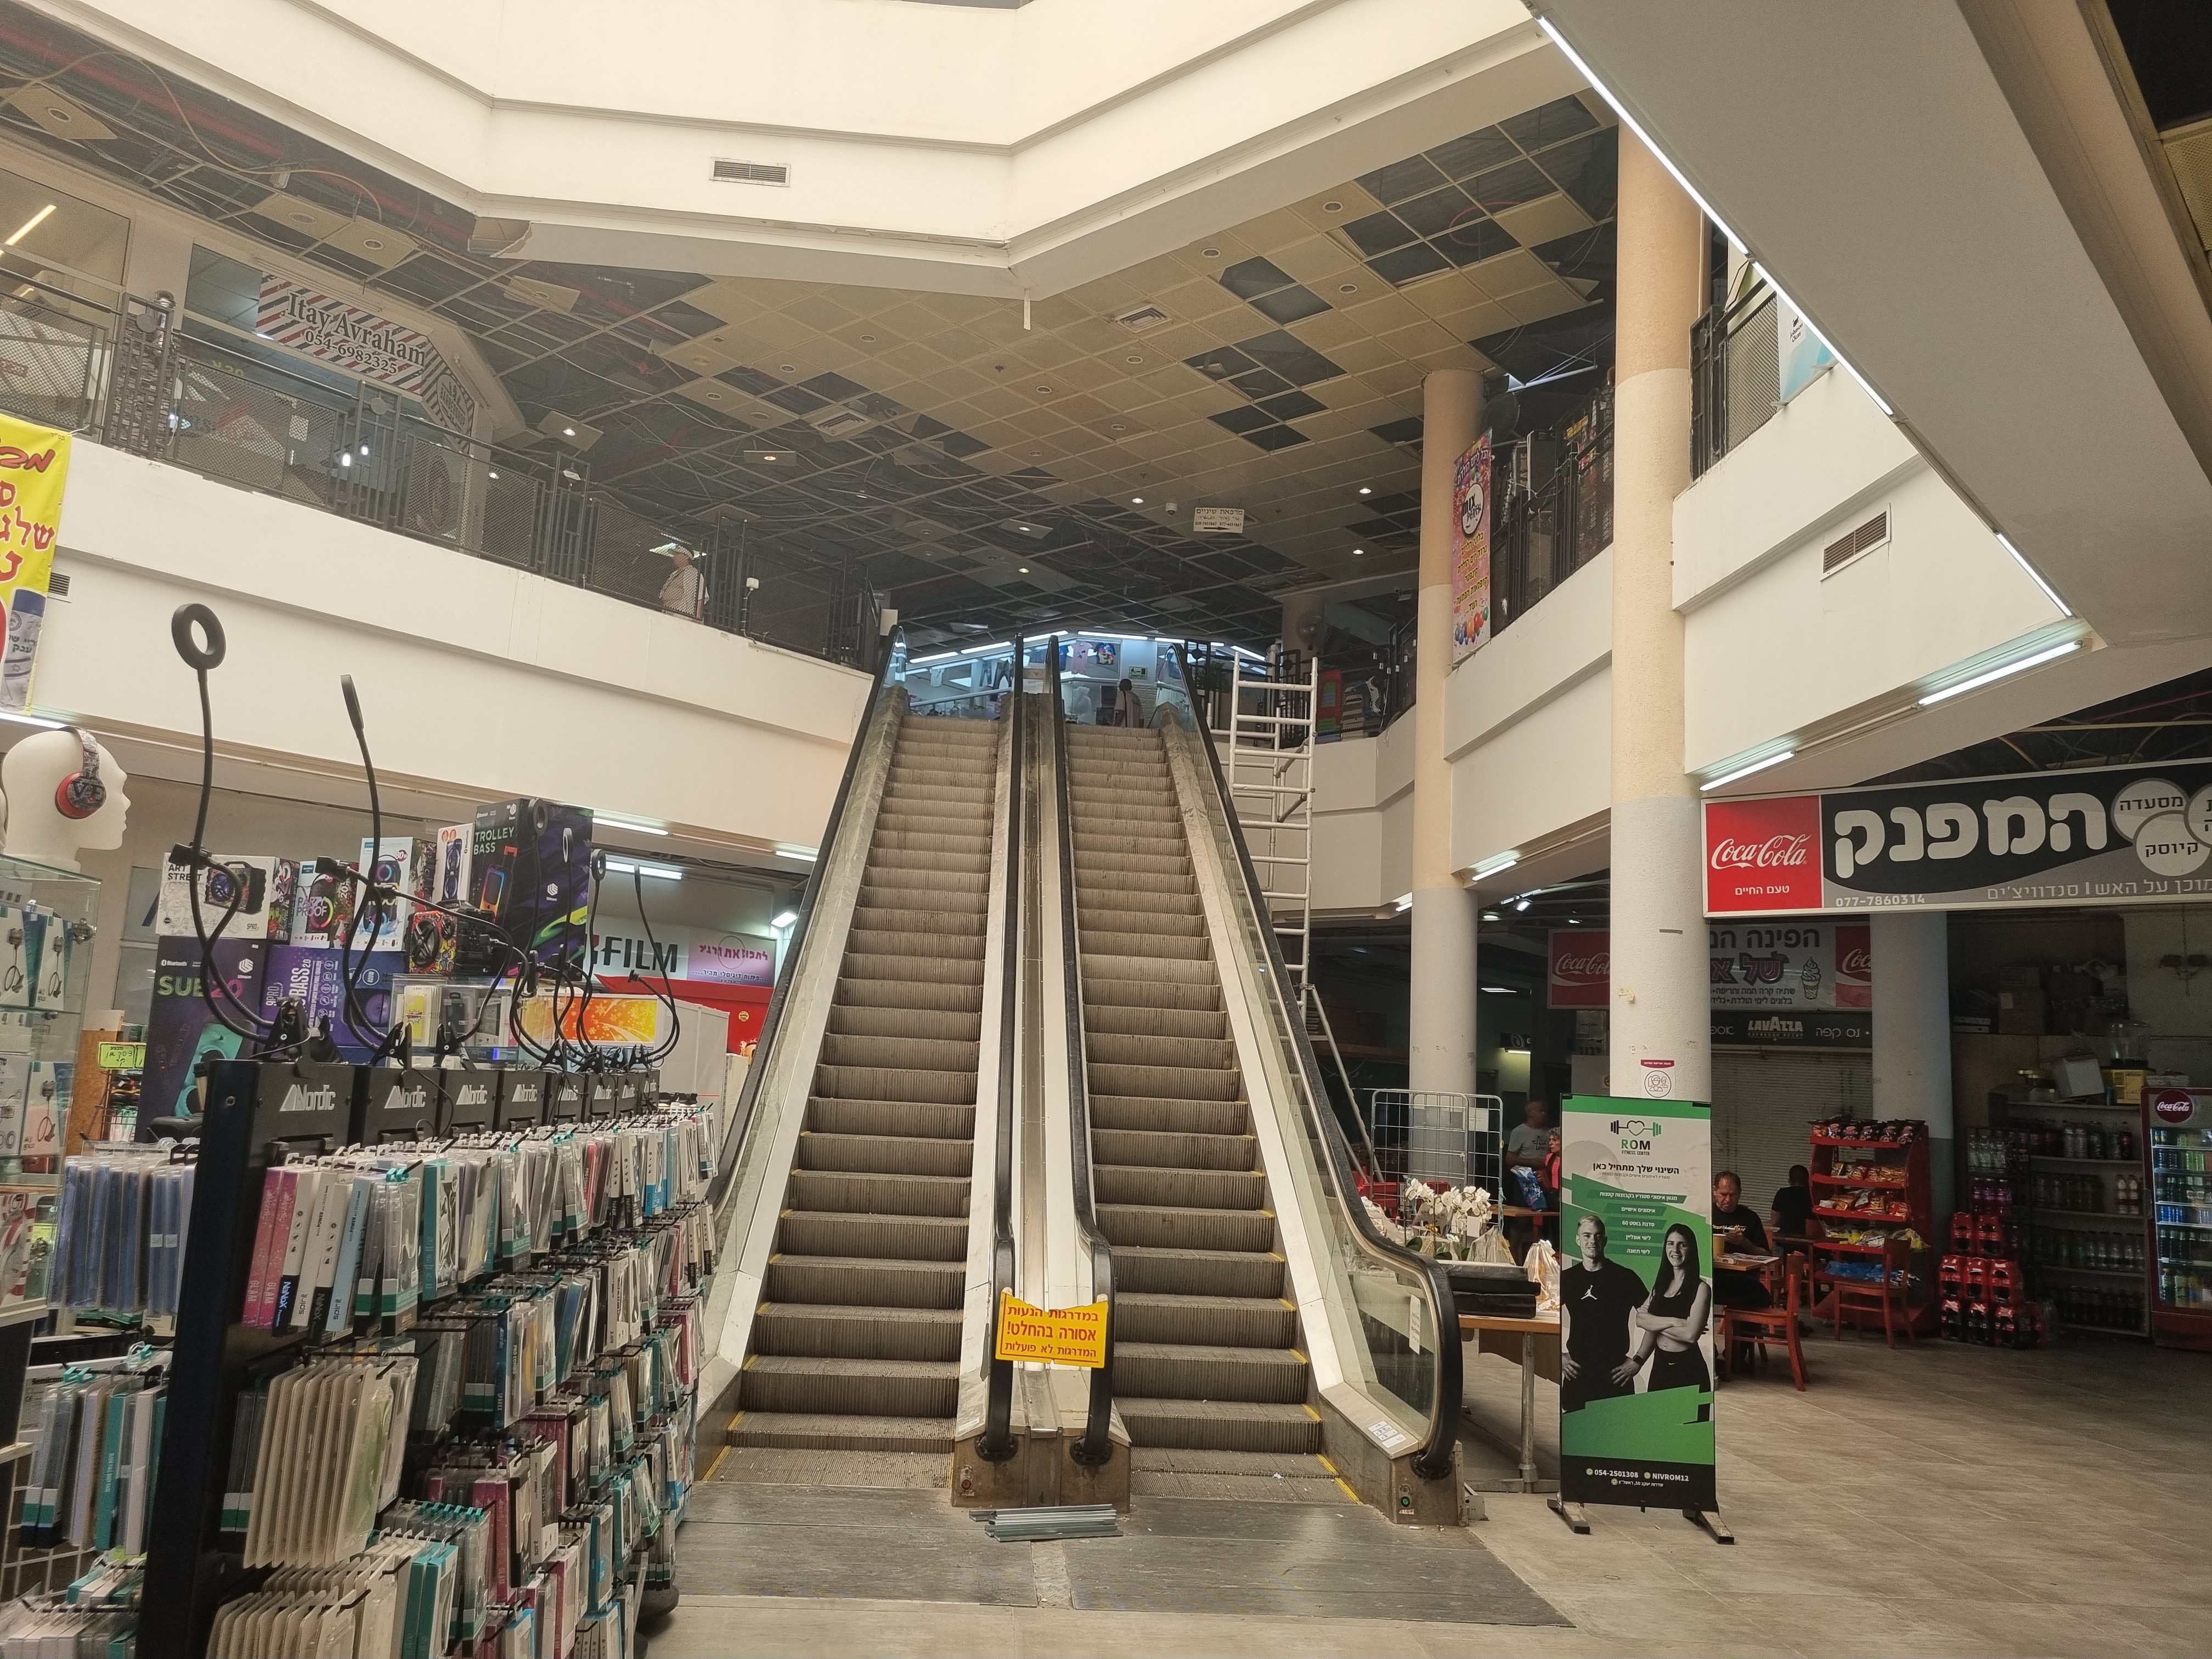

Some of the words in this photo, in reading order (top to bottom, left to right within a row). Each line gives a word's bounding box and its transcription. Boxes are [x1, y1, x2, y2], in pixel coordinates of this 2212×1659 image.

[287, 292, 331, 335] Itay
[333, 312, 425, 366] Avraham
[305, 330, 398, 374] 054-6982325
[2119, 796, 2184, 811] מסעדה
[475, 827, 515, 843] TROLLEY
[1834, 792, 2107, 878] המפנק
[473, 842, 496, 855] BASS
[1711, 834, 1812, 870] Coca-Cola
[2145, 842, 2198, 857] קיוסק
[167, 872, 202, 881] STRET
[1735, 886, 1763, 895] החיים
[1767, 885, 1790, 894] טעם
[2095, 881, 2137, 896] האש
[2143, 878, 2168, 893] על
[1836, 894, 1925, 907] 077-7860314
[296, 906, 328, 917] PROOF
[1747, 928, 1820, 949] הפינה
[1555, 952, 1610, 975] Coca-Col
[1739, 952, 1785, 986] של
[289, 967, 311, 997] BASS
[1748, 1016, 1803, 1032] LAVAZZA
[289, 1084, 336, 1111] Nordic
[460, 1085, 488, 1105] Nordic
[2157, 1101, 2190, 1111] Coca-Cola
[1621, 1139, 1651, 1150] ROM
[1593, 1163, 1606, 1171] כאן
[1608, 1163, 1634, 1171] מתחיל
[1636, 1164, 1653, 1173] שלך
[247, 1280, 259, 1302] GLAM
[263, 1282, 276, 1304] GLAM
[298, 1293, 308, 1315] spirit
[333, 1298, 342, 1320] spirit
[1006, 1321, 1053, 1339] בהחלט!
[1059, 1327, 1097, 1341] אסורה
[1005, 1341, 1036, 1353] פועלות
[1041, 1344, 1053, 1353] לא
[1057, 1346, 1097, 1358] המדרגות
[1594, 1469, 1639, 1478] 054-2501308
[1652, 1472, 1689, 1482] NIVROM12
